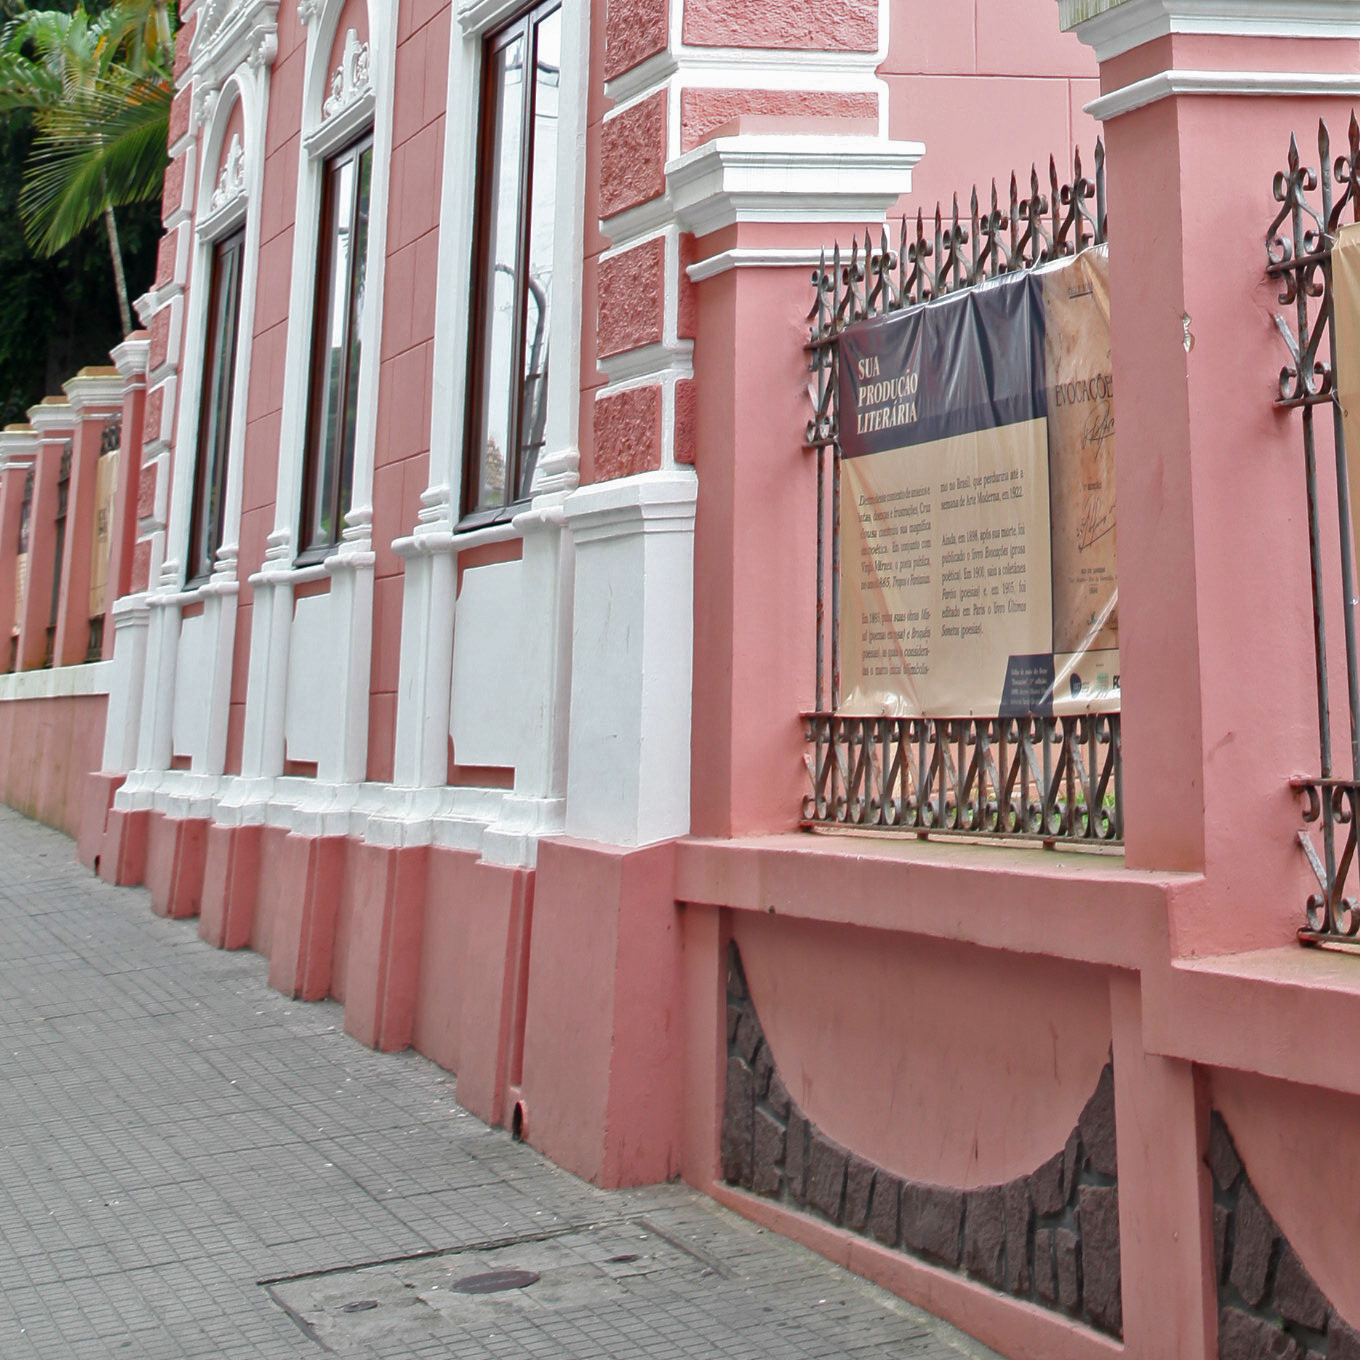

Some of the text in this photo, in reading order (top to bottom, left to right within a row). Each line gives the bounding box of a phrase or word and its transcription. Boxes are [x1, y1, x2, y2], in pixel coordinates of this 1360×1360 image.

[858, 355, 880, 381] SUA
[1055, 373, 1114, 408] EVOCAÇÕE
[856, 400, 918, 436] LITERÁRIA
